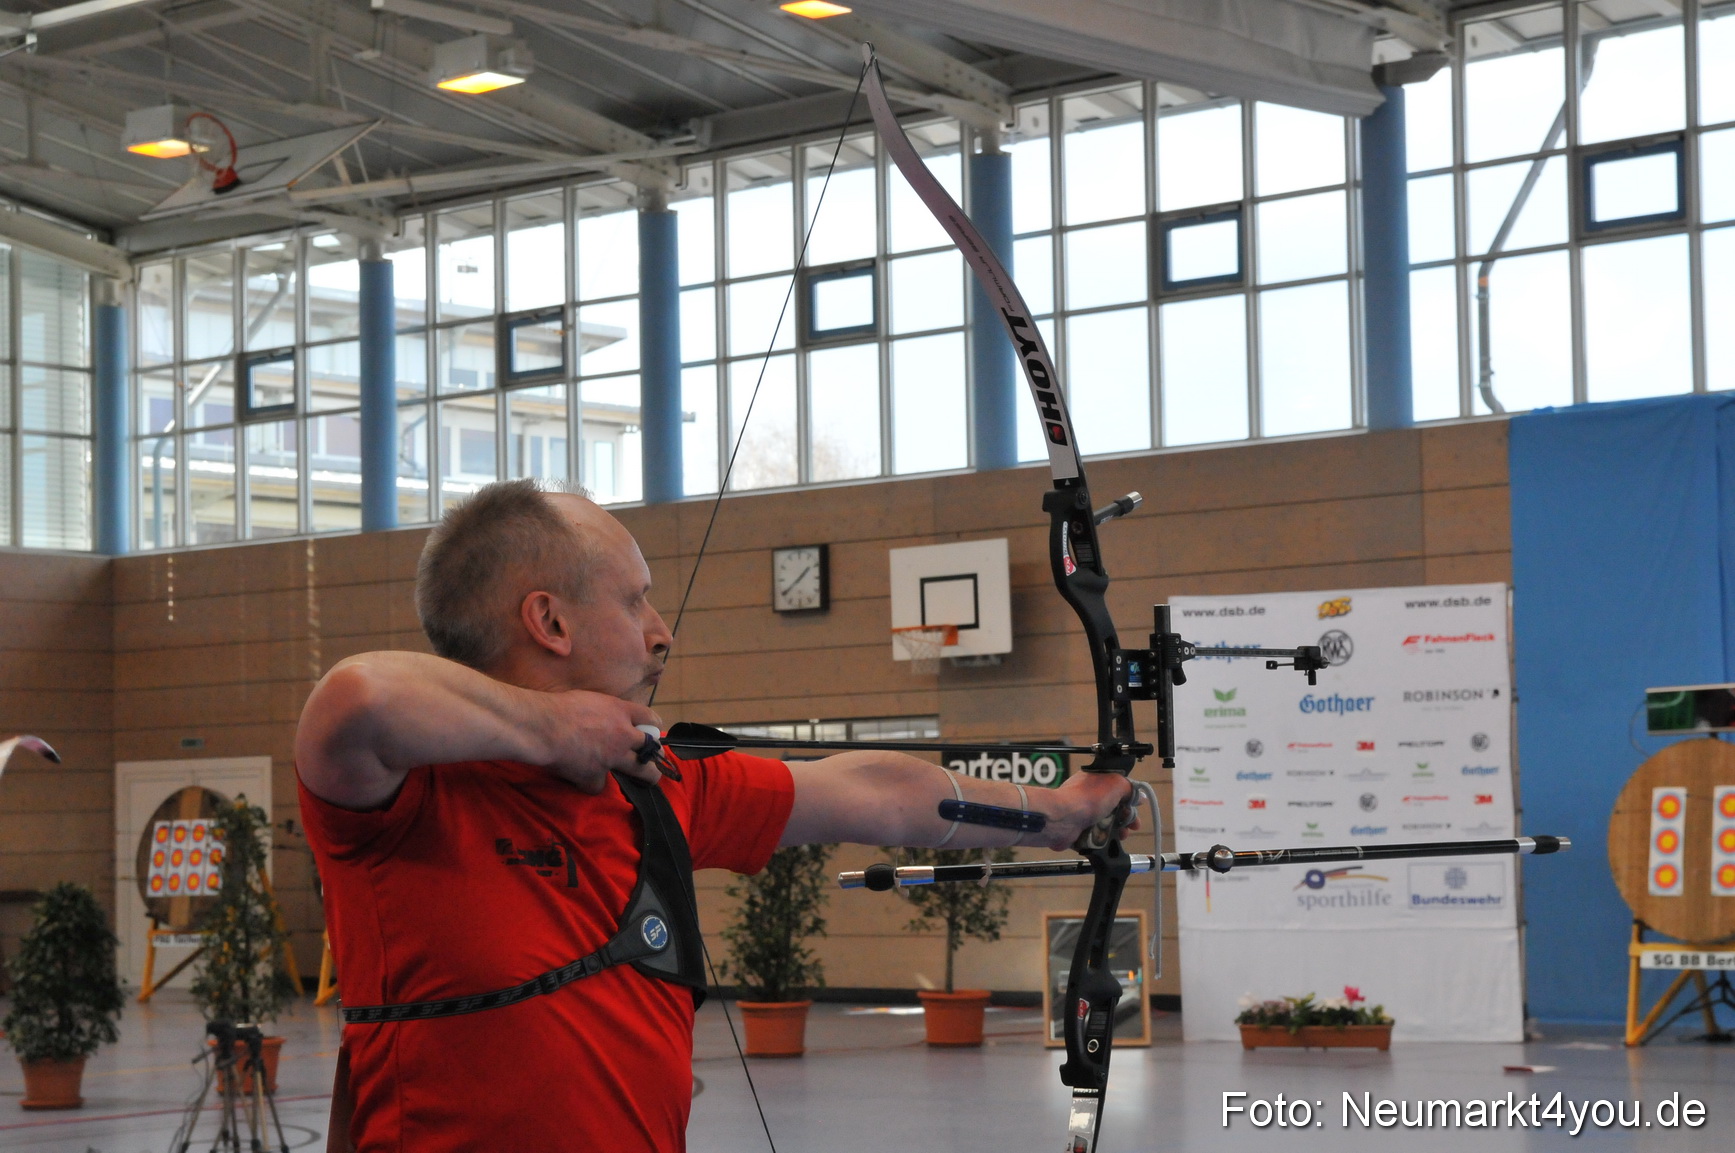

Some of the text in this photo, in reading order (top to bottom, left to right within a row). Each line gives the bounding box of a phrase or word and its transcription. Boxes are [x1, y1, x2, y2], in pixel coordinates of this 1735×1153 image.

[1001, 306, 1063, 422] HOYT
[1404, 596, 1492, 609] www.dsb.de
[1182, 605, 1266, 617] www.dsb.de
[1403, 689, 1484, 702] ROBINSON
[1299, 692, 1376, 716] Gothaer
[1203, 706, 1247, 718] erima
[949, 752, 1057, 785] artebo
[1297, 888, 1393, 911] sporthilfe
[1411, 892, 1502, 906] Bundeswehr
[650, 923, 662, 941] SF
[1653, 953, 1673, 966] SG
